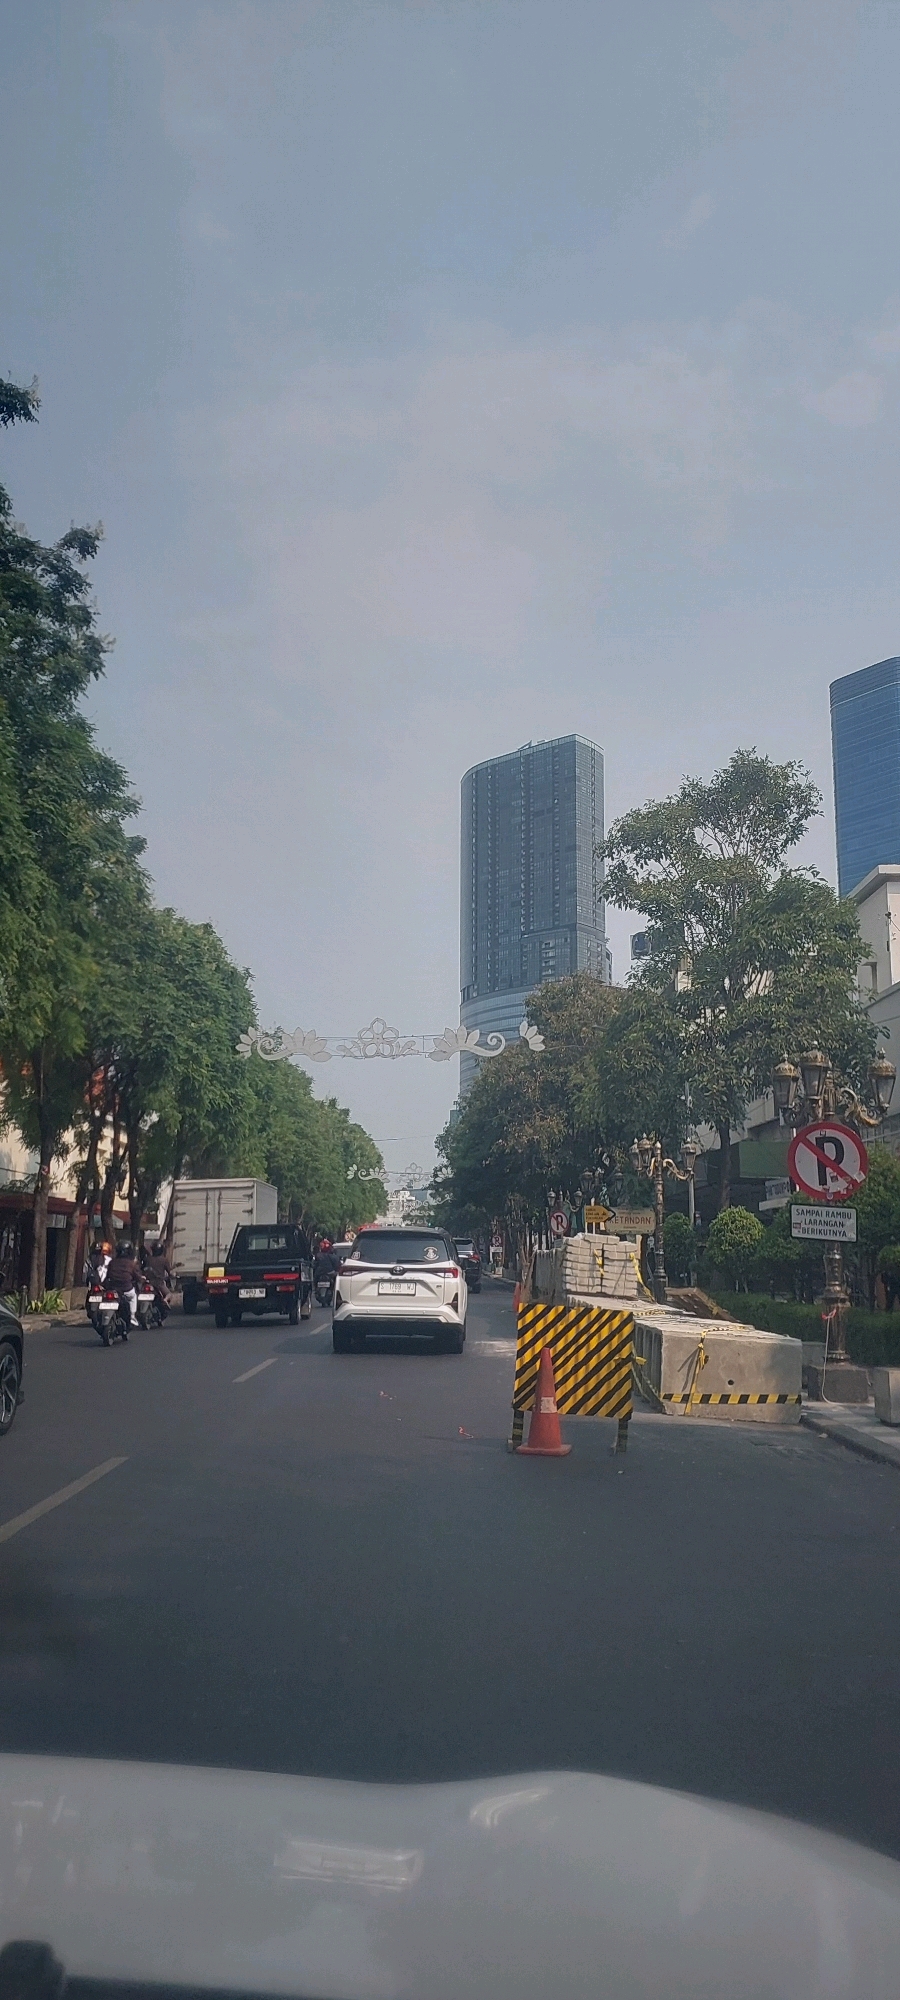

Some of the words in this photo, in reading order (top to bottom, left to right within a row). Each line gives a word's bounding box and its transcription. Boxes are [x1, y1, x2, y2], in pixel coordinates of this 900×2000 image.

[795, 1208, 823, 1217] SAMPAI
[825, 1210, 852, 1220] RAMBU
[804, 1218, 844, 1229] LARANGAN
[801, 1226, 847, 1238] BERIKUTNYA
